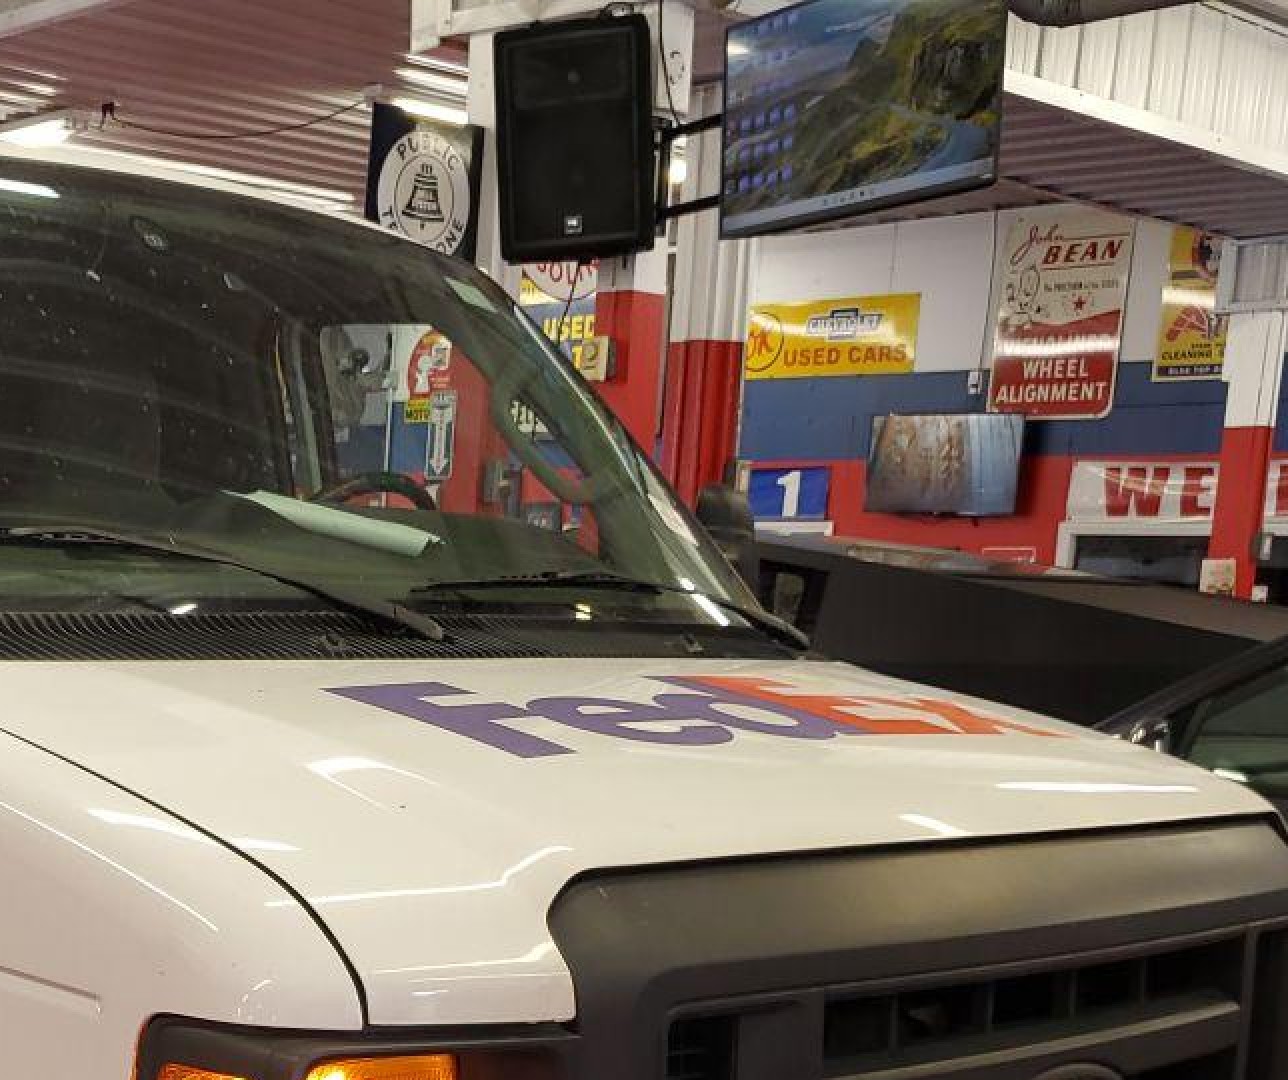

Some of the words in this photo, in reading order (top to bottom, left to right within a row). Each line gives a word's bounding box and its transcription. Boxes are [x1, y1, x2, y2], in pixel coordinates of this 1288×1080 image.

[397, 130, 461, 173] PUBLIC
[1041, 240, 1124, 265] BEAN
[782, 346, 841, 367] USED
[847, 343, 908, 364] CARS
[1023, 357, 1090, 380] WHEEL
[995, 381, 1108, 404] ALIGNMENT
[317, 674, 1074, 759] FedEx
